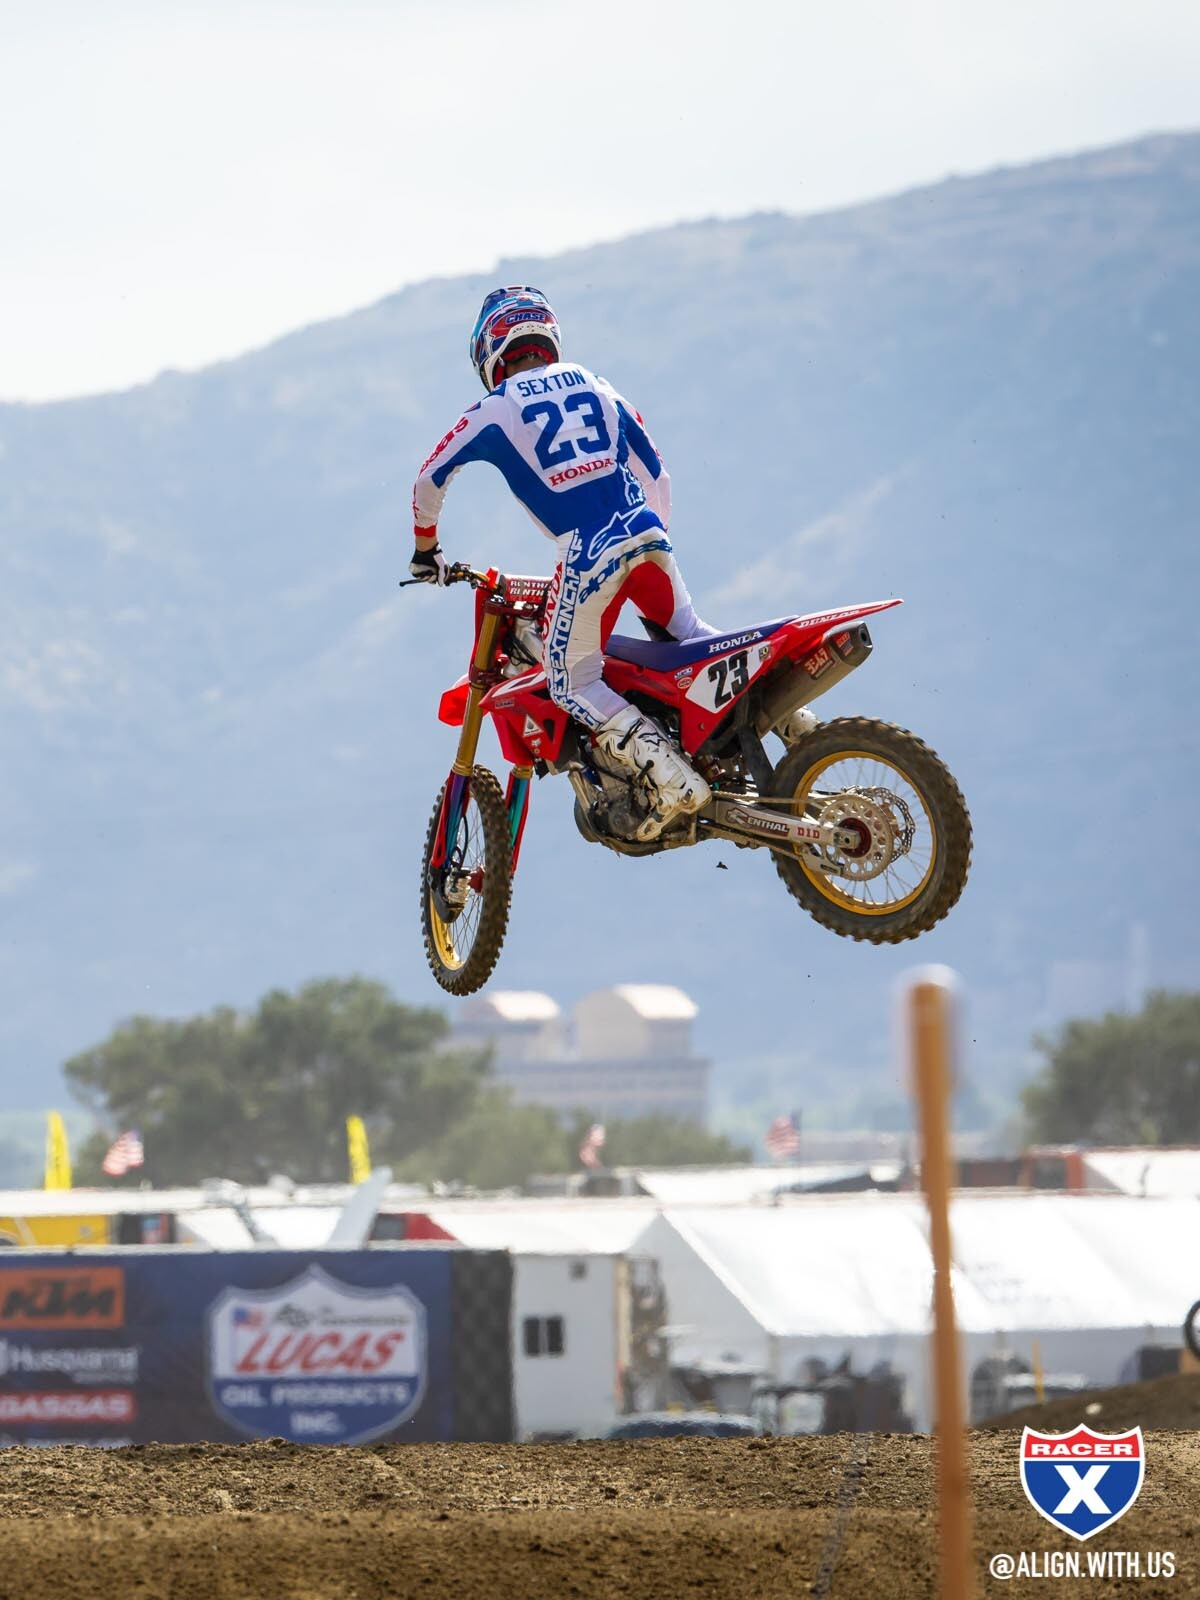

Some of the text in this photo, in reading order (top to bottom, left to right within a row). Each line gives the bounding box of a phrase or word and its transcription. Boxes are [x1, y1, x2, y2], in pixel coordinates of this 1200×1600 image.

[506, 312, 546, 324] CHASE
[516, 369, 587, 398] SEXTON
[521, 391, 612, 471] 23
[549, 457, 615, 487] HONDA
[708, 630, 763, 654] HONDA
[707, 649, 750, 709] 23
[1, 1281, 116, 1318] KTM
[234, 1329, 405, 1374] LUCAS
[220, 1384, 267, 1408] OIL
